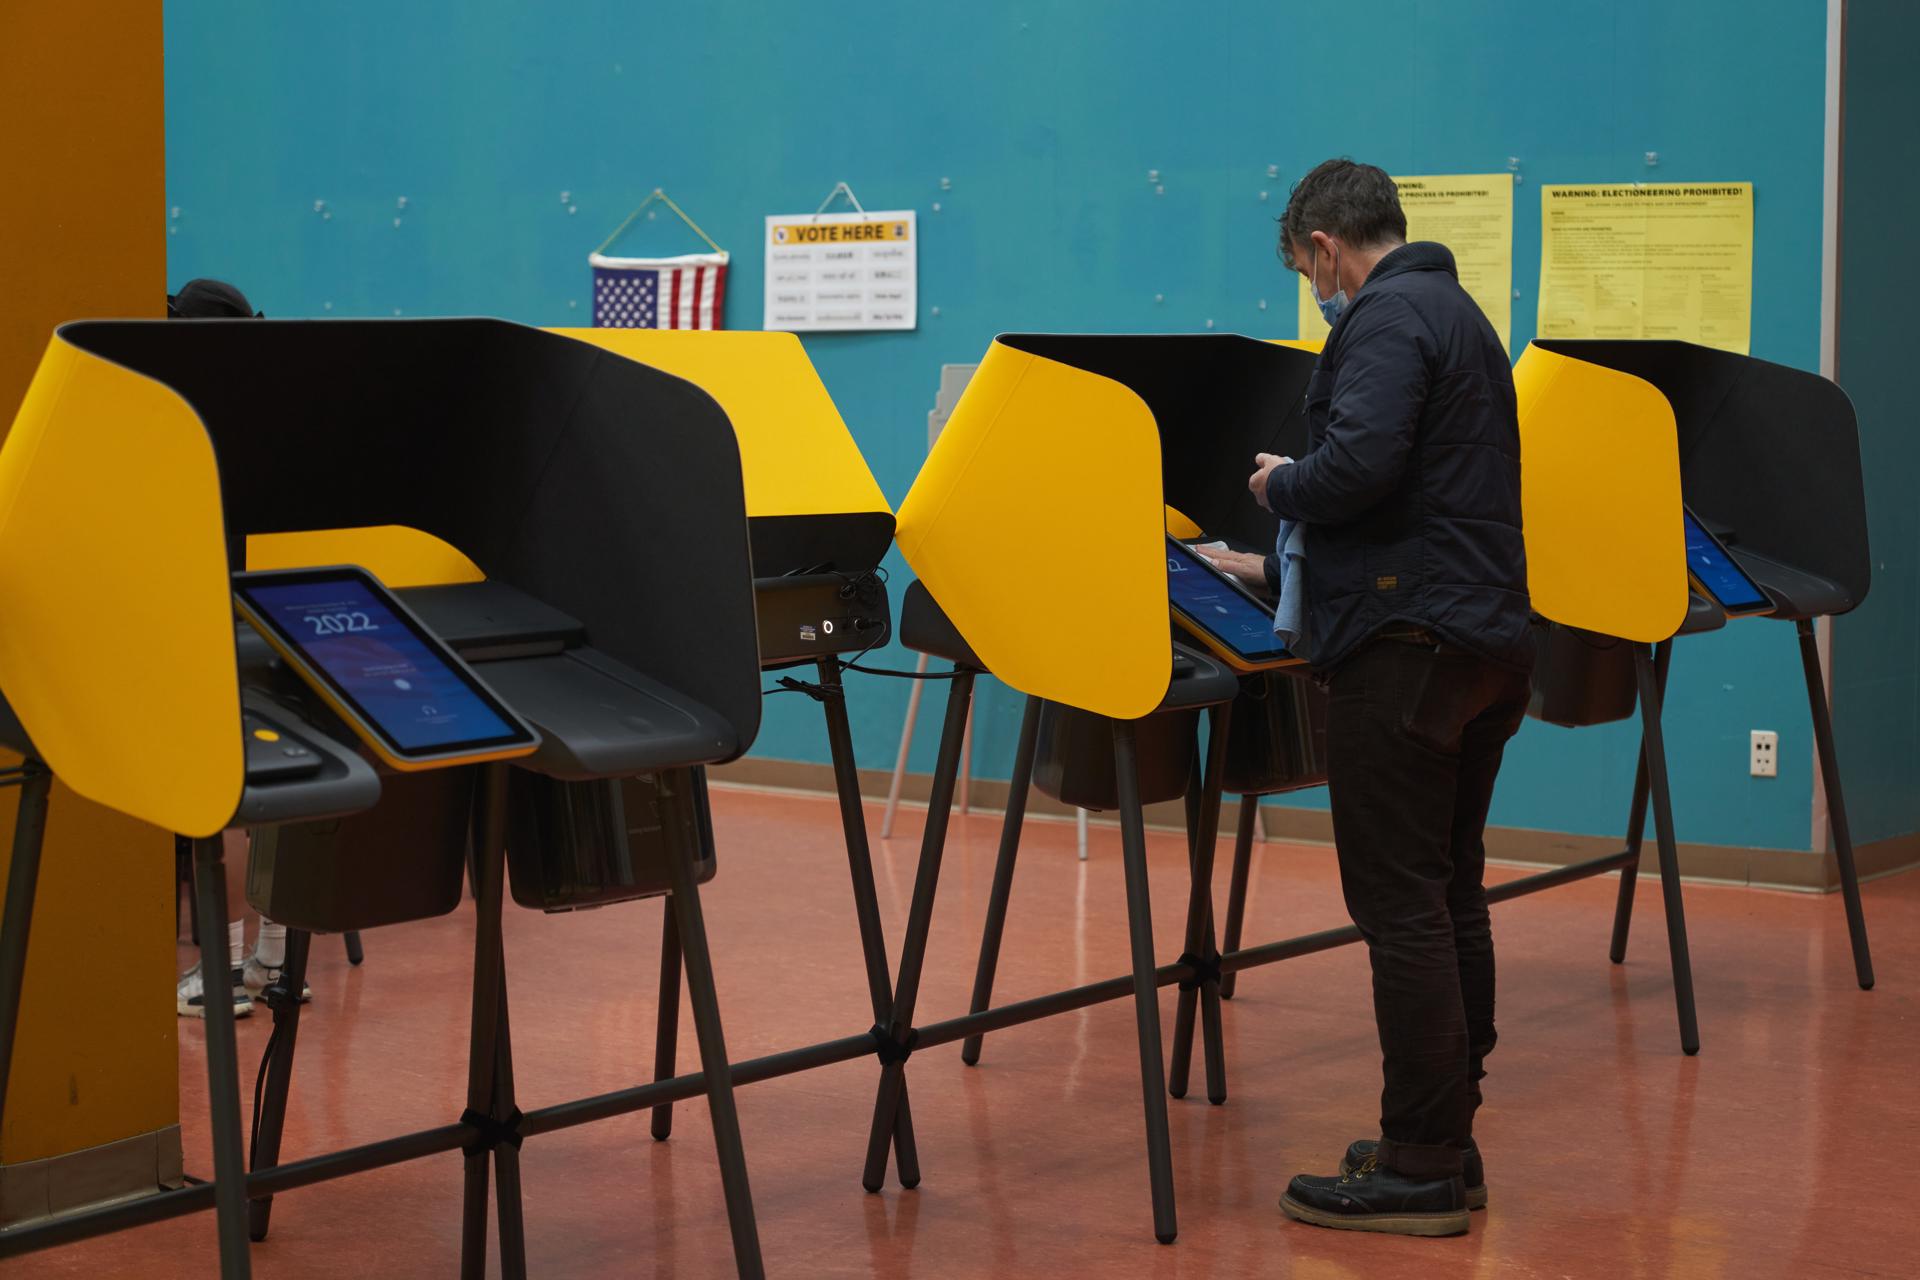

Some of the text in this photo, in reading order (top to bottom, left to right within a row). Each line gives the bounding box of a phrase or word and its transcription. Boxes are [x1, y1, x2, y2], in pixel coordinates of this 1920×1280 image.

[1438, 190, 1445, 198] IS
[1552, 187, 1743, 198] WARNING: ELECTIONEERING PROHIBITED!
[796, 224, 884, 241] VOTE HERE
[303, 611, 379, 635] 2022
